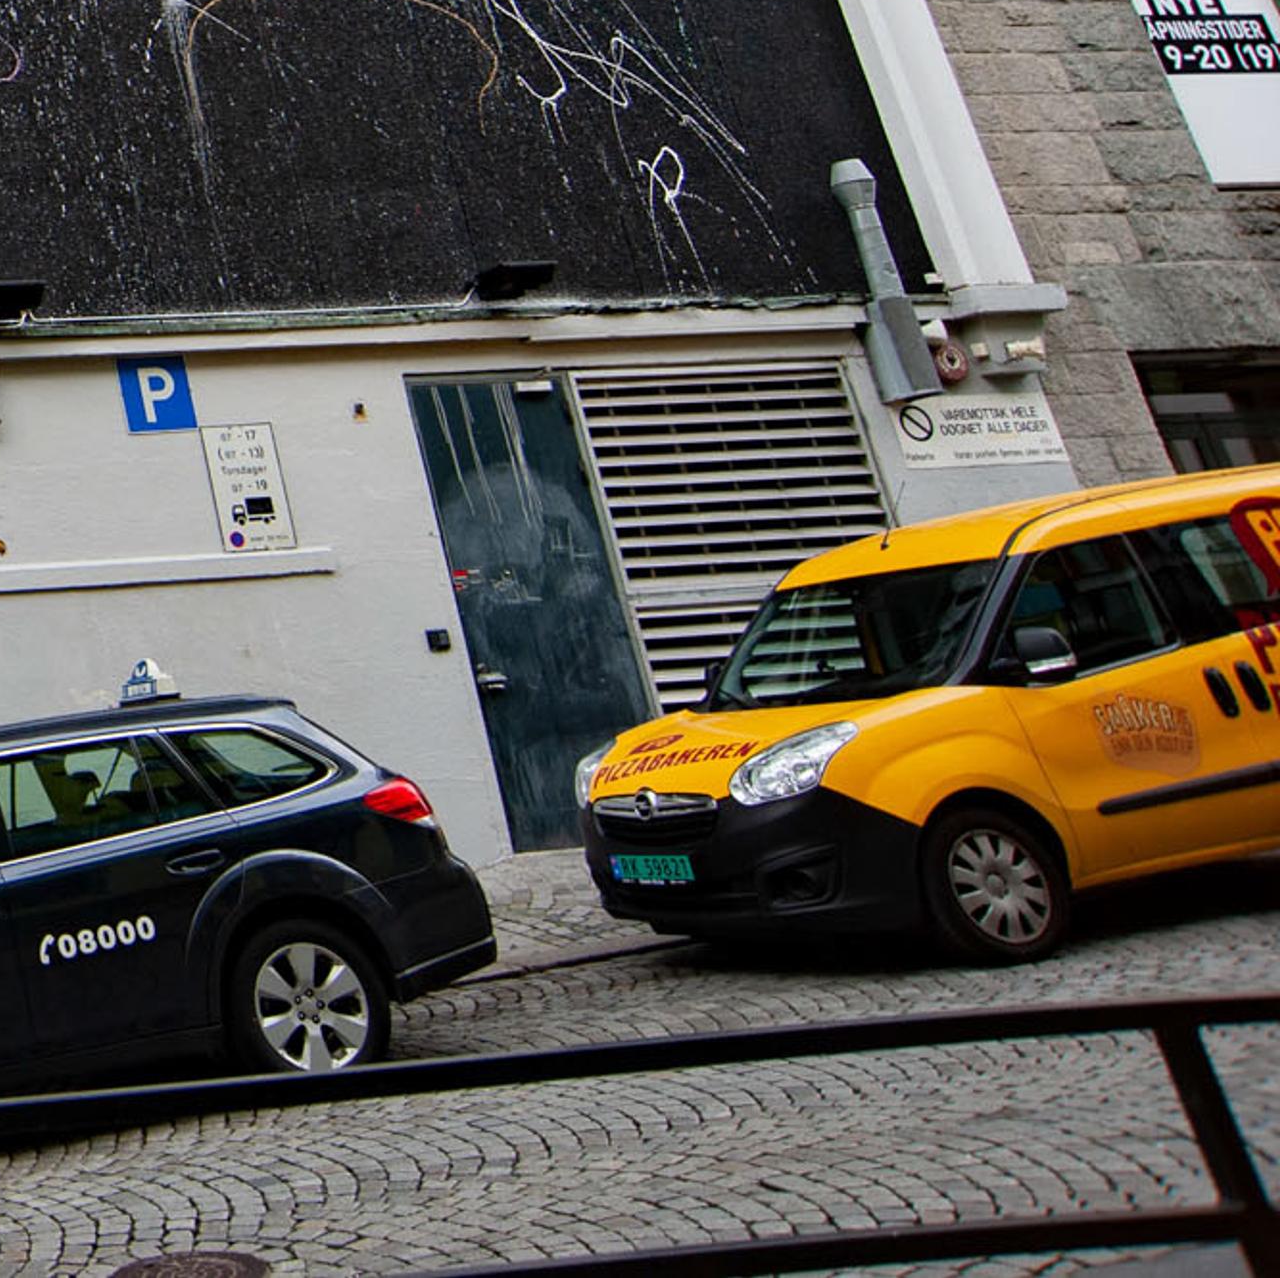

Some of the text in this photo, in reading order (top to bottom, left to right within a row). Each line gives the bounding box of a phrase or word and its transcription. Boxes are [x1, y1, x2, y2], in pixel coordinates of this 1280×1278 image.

[1163, 44, 1232, 70] 9-20
[137, 367, 175, 423] P
[942, 406, 1037, 421] VAREMOTTAK HELE
[987, 422, 1011, 434] ALLE
[1015, 420, 1050, 433] DAGER
[594, 741, 759, 790] PIZZABAKEREN
[57, 915, 156, 959] 08000
